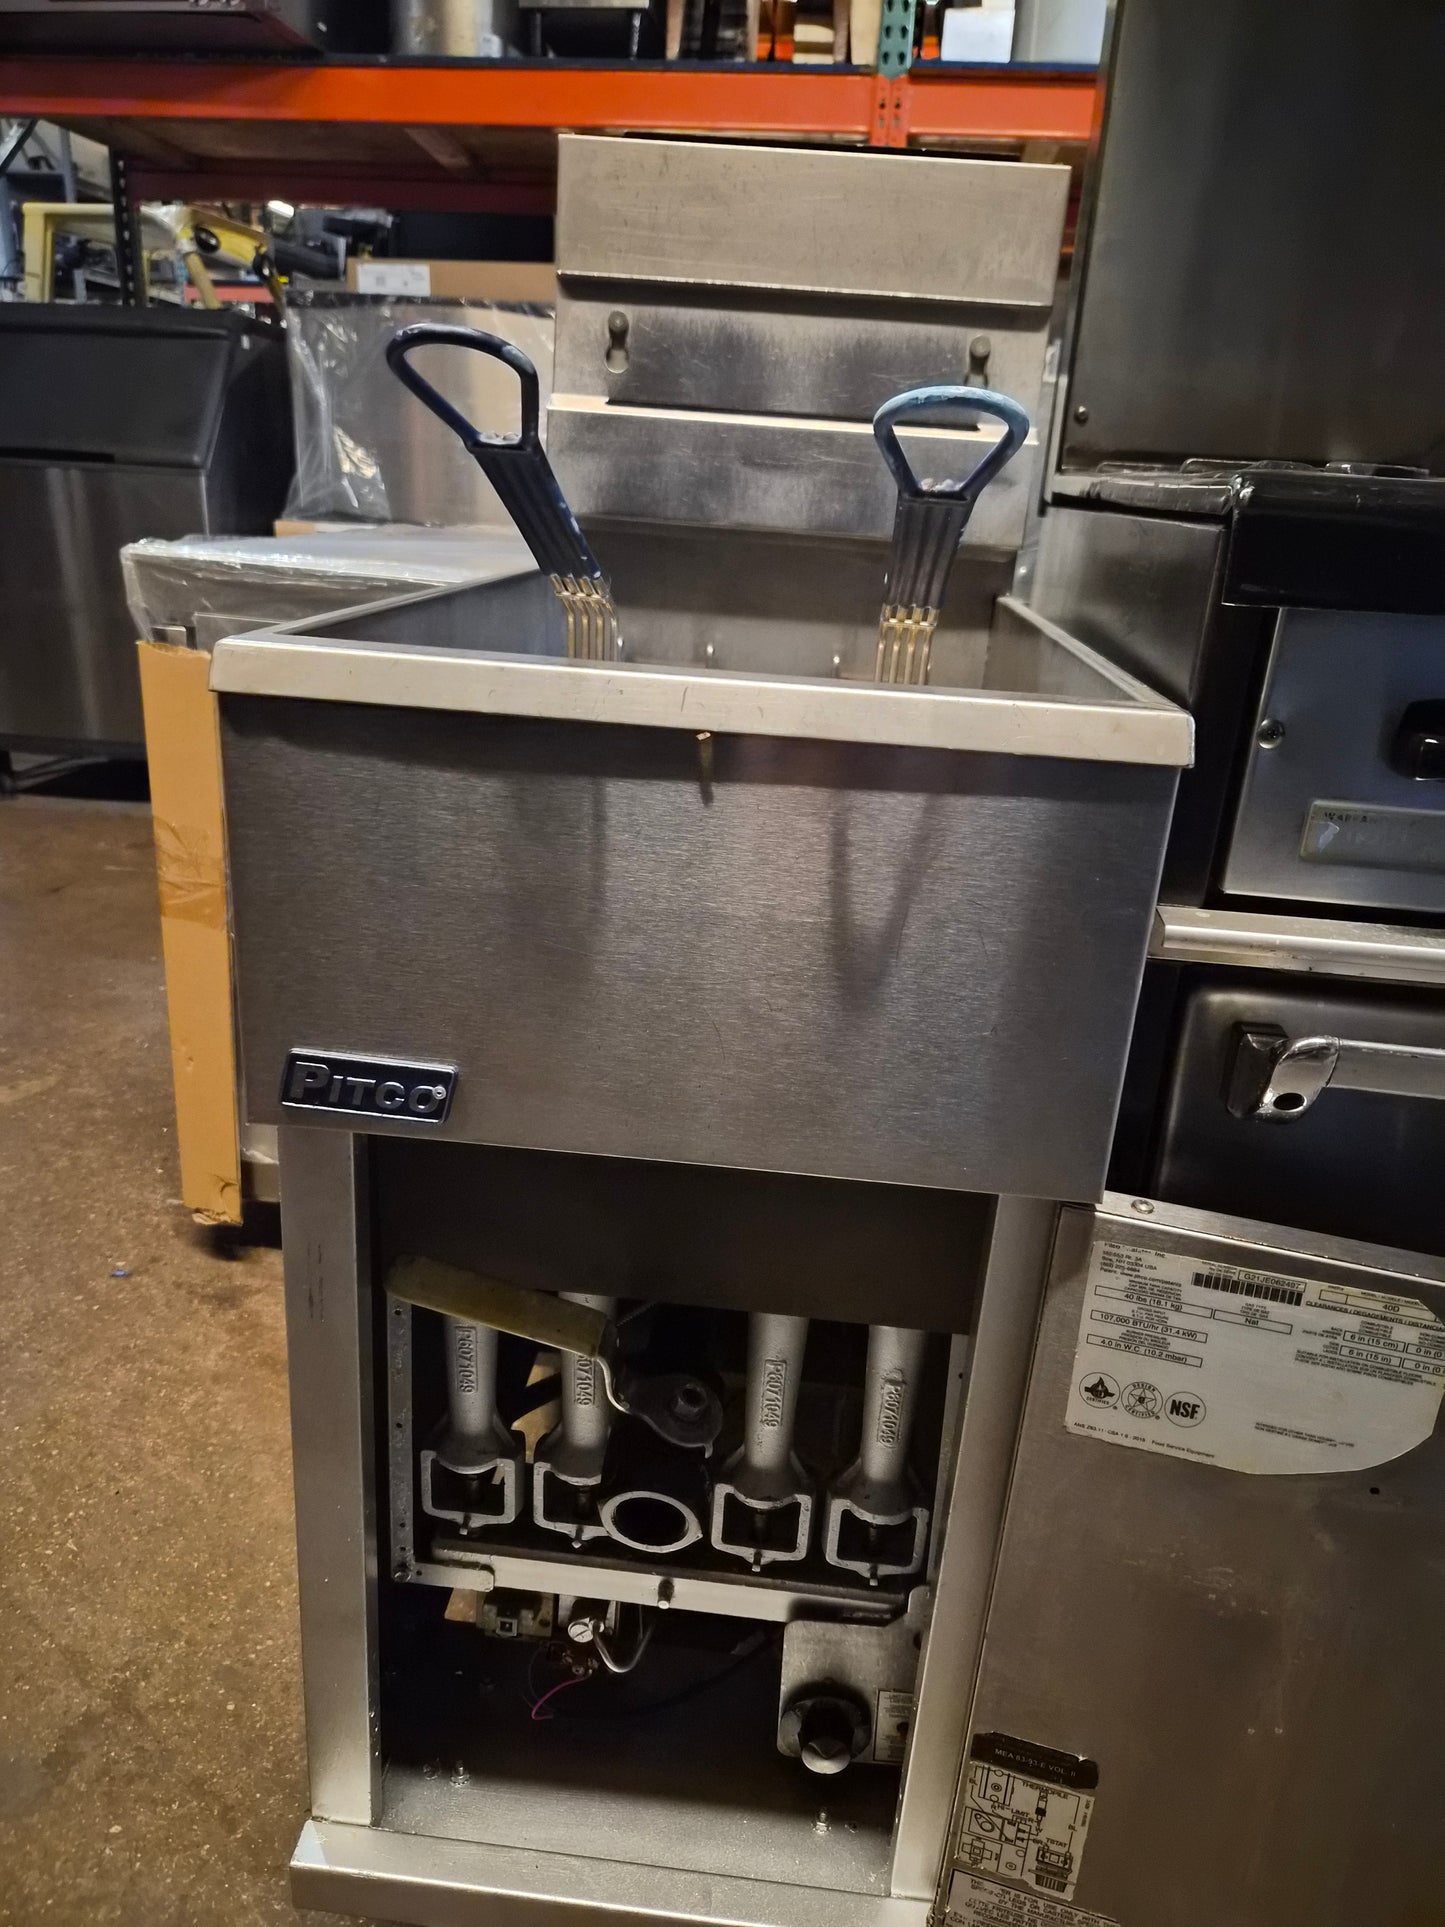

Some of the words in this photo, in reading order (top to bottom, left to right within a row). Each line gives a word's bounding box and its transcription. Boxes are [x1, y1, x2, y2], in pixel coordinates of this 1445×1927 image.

[289, 1061, 440, 1113] PITCO
[1148, 1298, 1168, 1308] (18.1
[1170, 1302, 1183, 1312] kg)
[1306, 1300, 1348, 1314] CLEARANCES
[1382, 1304, 1400, 1313] 40D
[1100, 1313, 1130, 1325] 107,000
[1132, 1318, 1160, 1331] BTU/hr
[1160, 1324, 1180, 1336] (31.4
[1182, 1330, 1198, 1340] kW)
[1245, 1318, 1259, 1326] Nat
[1367, 1336, 1381, 1346] (15
[1382, 1340, 1398, 1350] cm)
[1100, 1338, 1113, 1347] 4.0
[1144, 1348, 1164, 1359] (10.2
[1164, 1352, 1188, 1364] mbar)
[1366, 1352, 1380, 1361] (15
[1382, 1355, 1392, 1364] in)
[457, 1328, 476, 1393] P6071049
[1170, 1399, 1200, 1420] NSF
[1166, 1444, 1185, 1452] Service
[1186, 1447, 1215, 1459] Equipment
[994, 1748, 1014, 1758] MEA
[1008, 1896, 1026, 1907] LEGS
[1030, 1902, 1040, 1911] OR
[1043, 1908, 1075, 1922] CASTERS
[1011, 1902, 1024, 1912] THE
[1024, 1894, 1039, 1904] FOR
[1043, 1902, 1058, 1911] USE
[1060, 1908, 1080, 1920] ONLY
